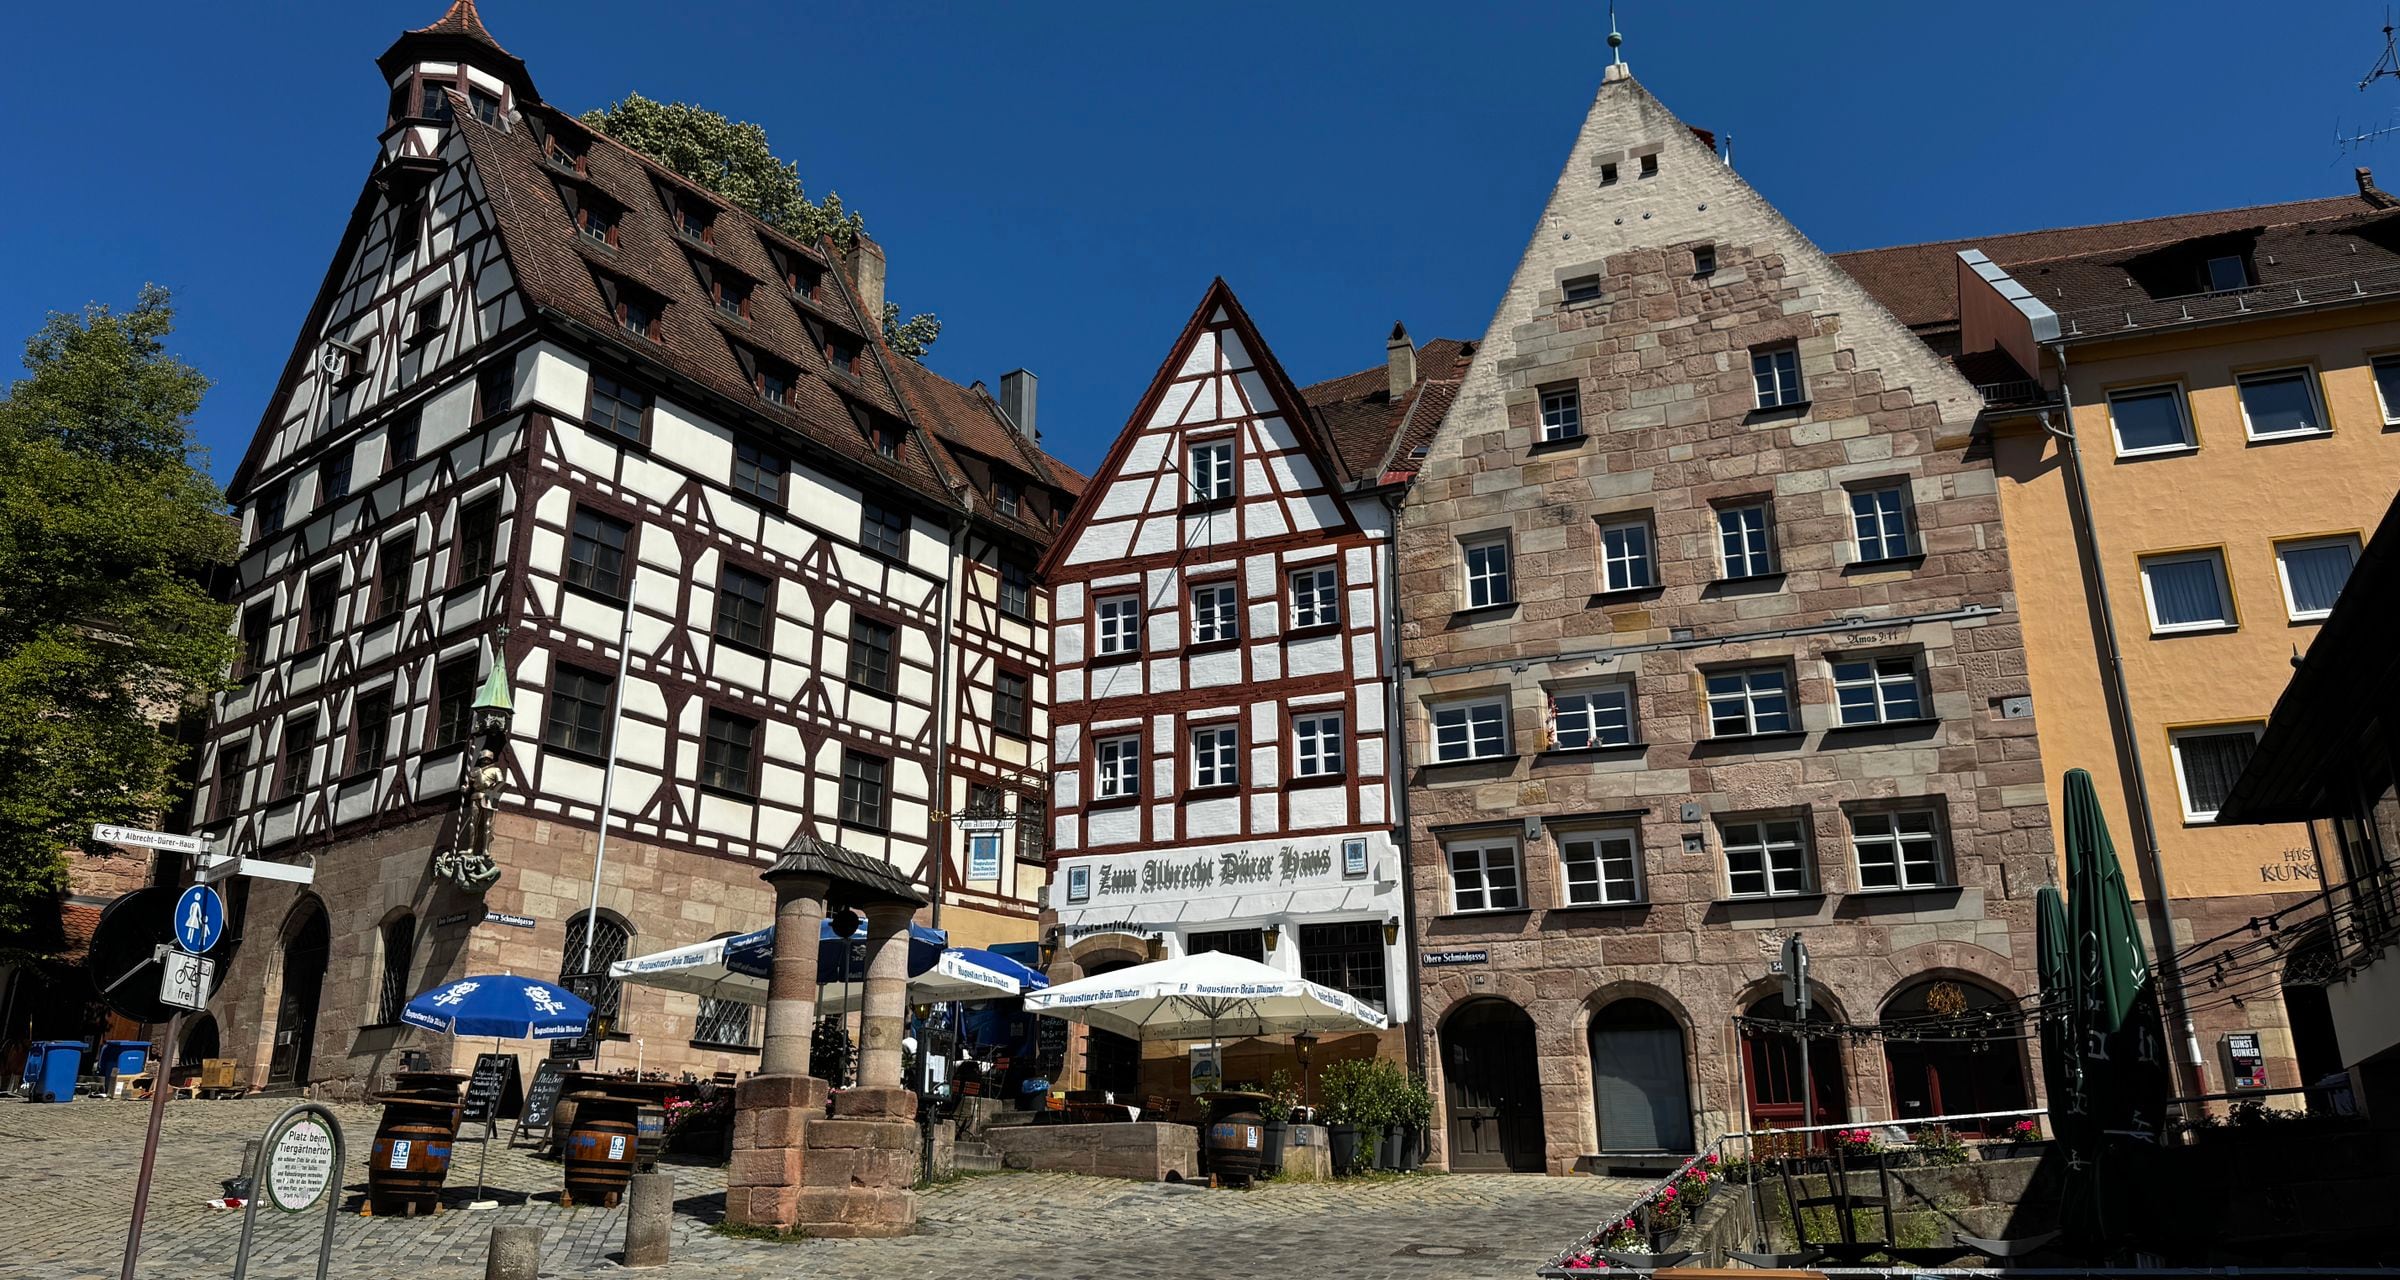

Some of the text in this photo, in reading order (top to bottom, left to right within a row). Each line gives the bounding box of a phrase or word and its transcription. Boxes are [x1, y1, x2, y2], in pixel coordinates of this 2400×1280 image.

[1847, 633, 1877, 644] Amos
[125, 832, 195, 849] Albrecht-Dürer-Haus
[2283, 847, 2312, 861] HIS
[1097, 845, 1332, 895] Zum Albrecht Dürer Haus
[177, 988, 193, 1001] frei
[1114, 989, 1140, 999] München
[1256, 984, 1284, 993] München
[2230, 1040, 2253, 1049] KUNST
[2231, 1048, 2260, 1057] BUNKER
[289, 1130, 327, 1143] Platz beim
[280, 1142, 331, 1156] Tiergärtnertor
